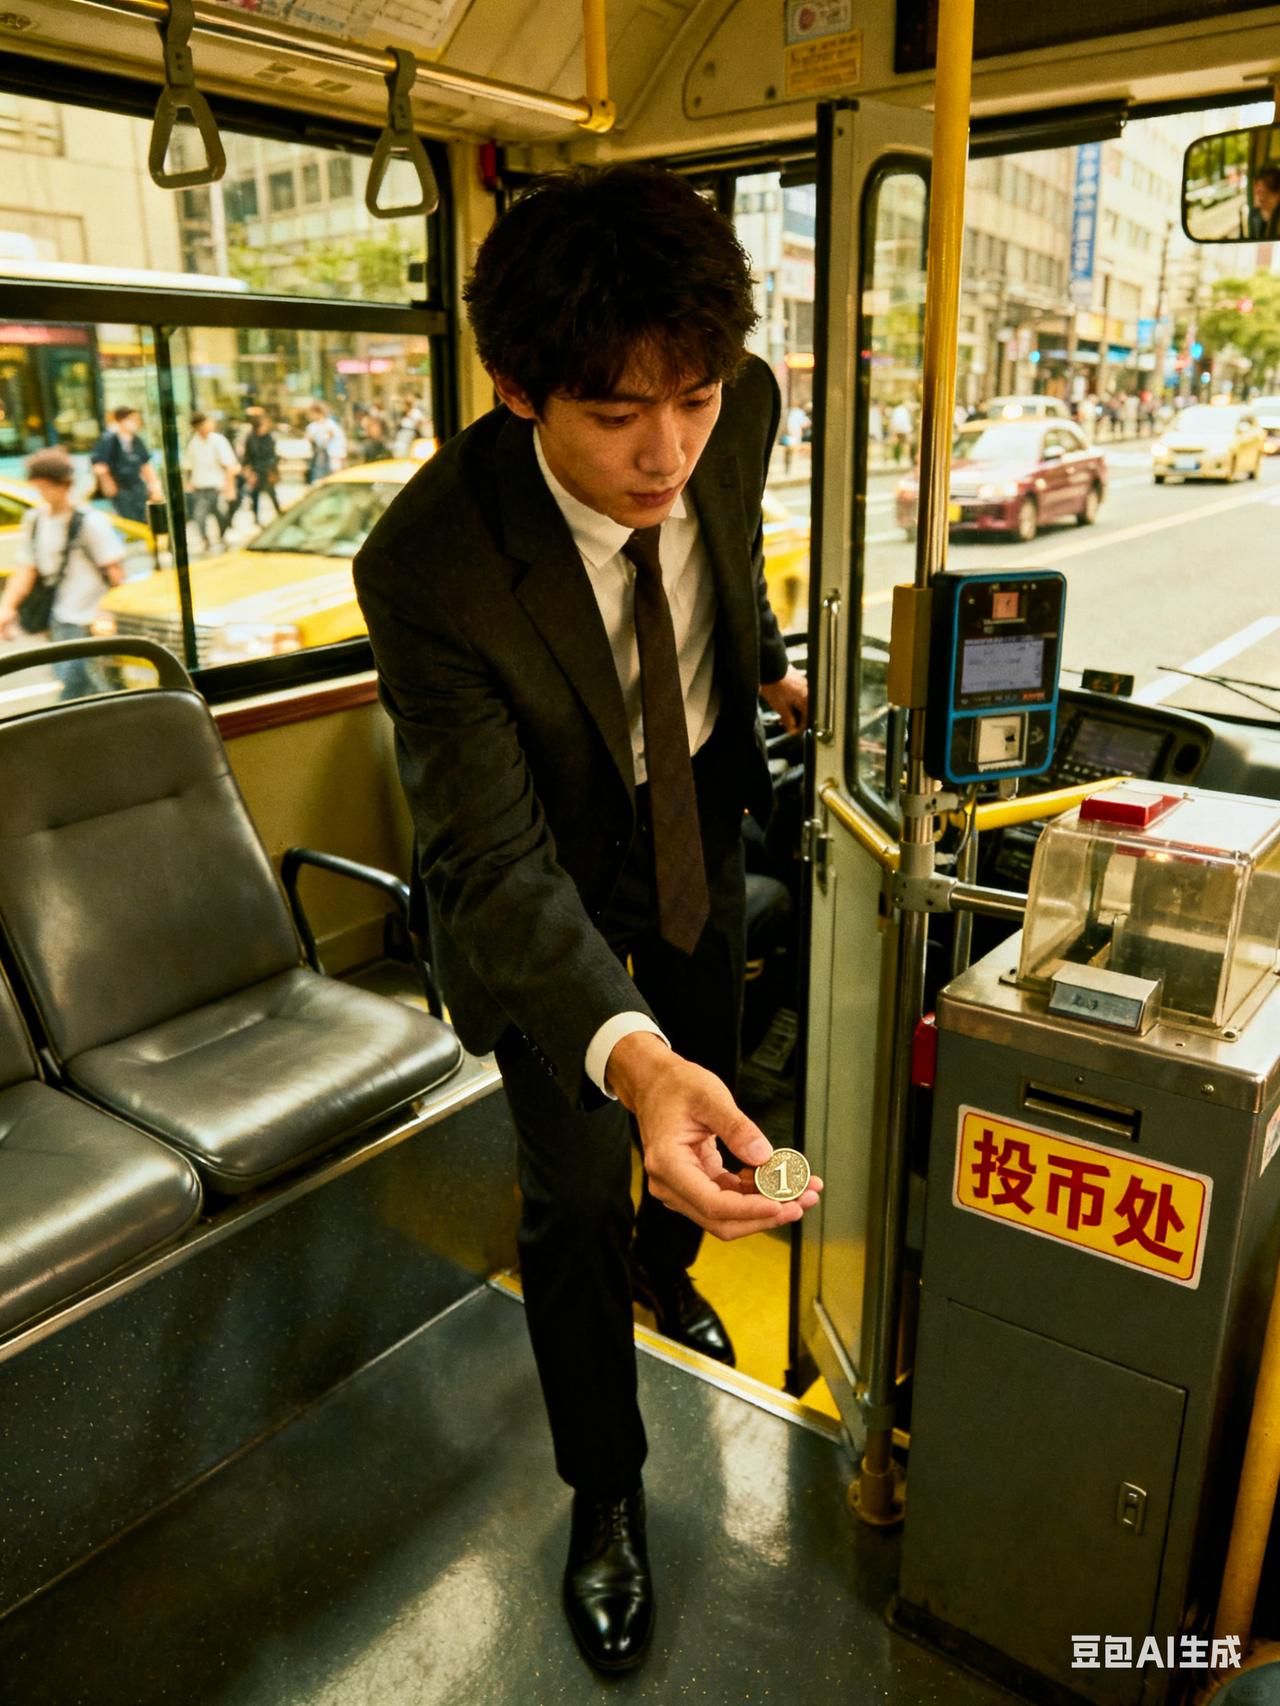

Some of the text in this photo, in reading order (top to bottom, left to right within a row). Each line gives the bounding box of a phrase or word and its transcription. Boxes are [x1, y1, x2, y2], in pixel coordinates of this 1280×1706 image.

[774, 1160, 792, 1195] 1
[972, 1129, 1184, 1263] 投币处
